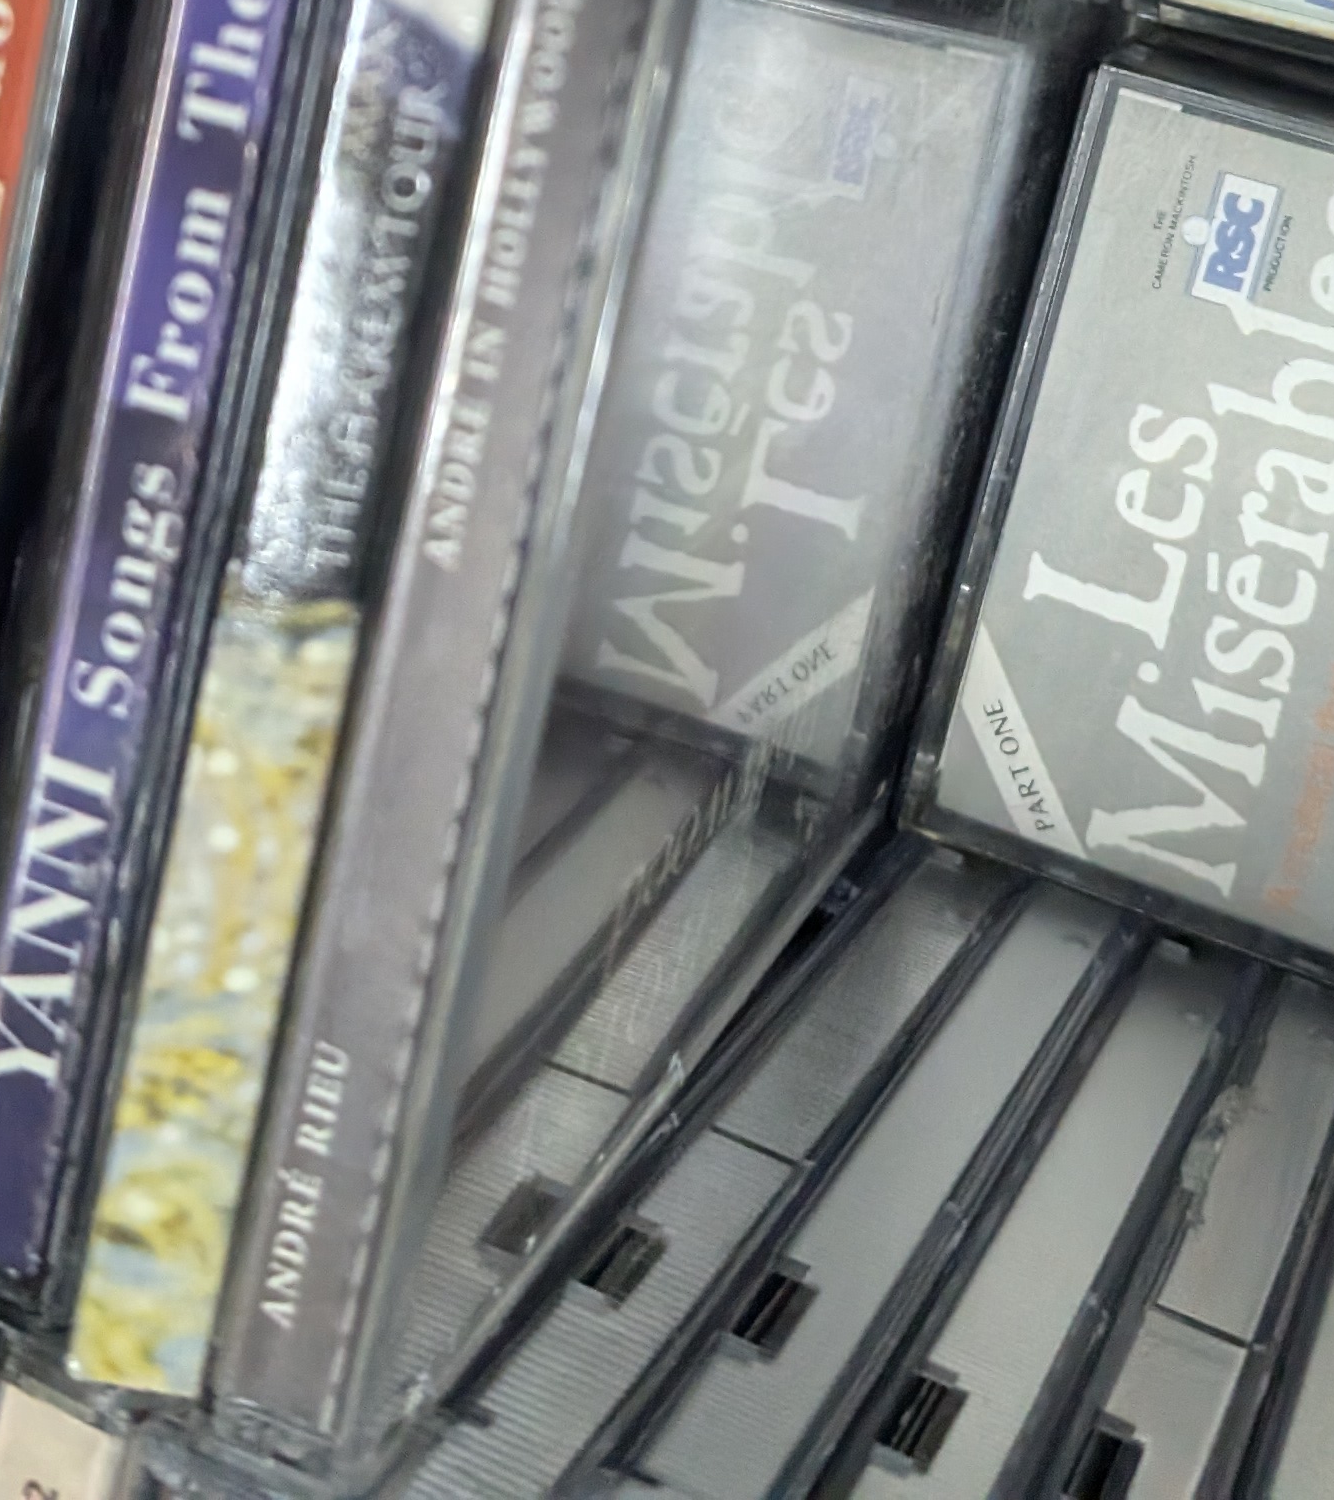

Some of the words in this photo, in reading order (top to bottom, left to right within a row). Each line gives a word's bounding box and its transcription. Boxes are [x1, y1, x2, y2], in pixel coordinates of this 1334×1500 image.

[124, 186, 235, 424] From
[1203, 190, 1266, 293] RSC
[1262, 213, 1294, 293] PRODUCTION
[71, 460, 179, 721] Songs
[1021, 404, 1219, 650] Les
[982, 698, 1021, 757] ONE
[1017, 757, 1056, 833] PART
[257, 1164, 324, 1330] ANDRÉ
[297, 1040, 352, 1157] RIEU
